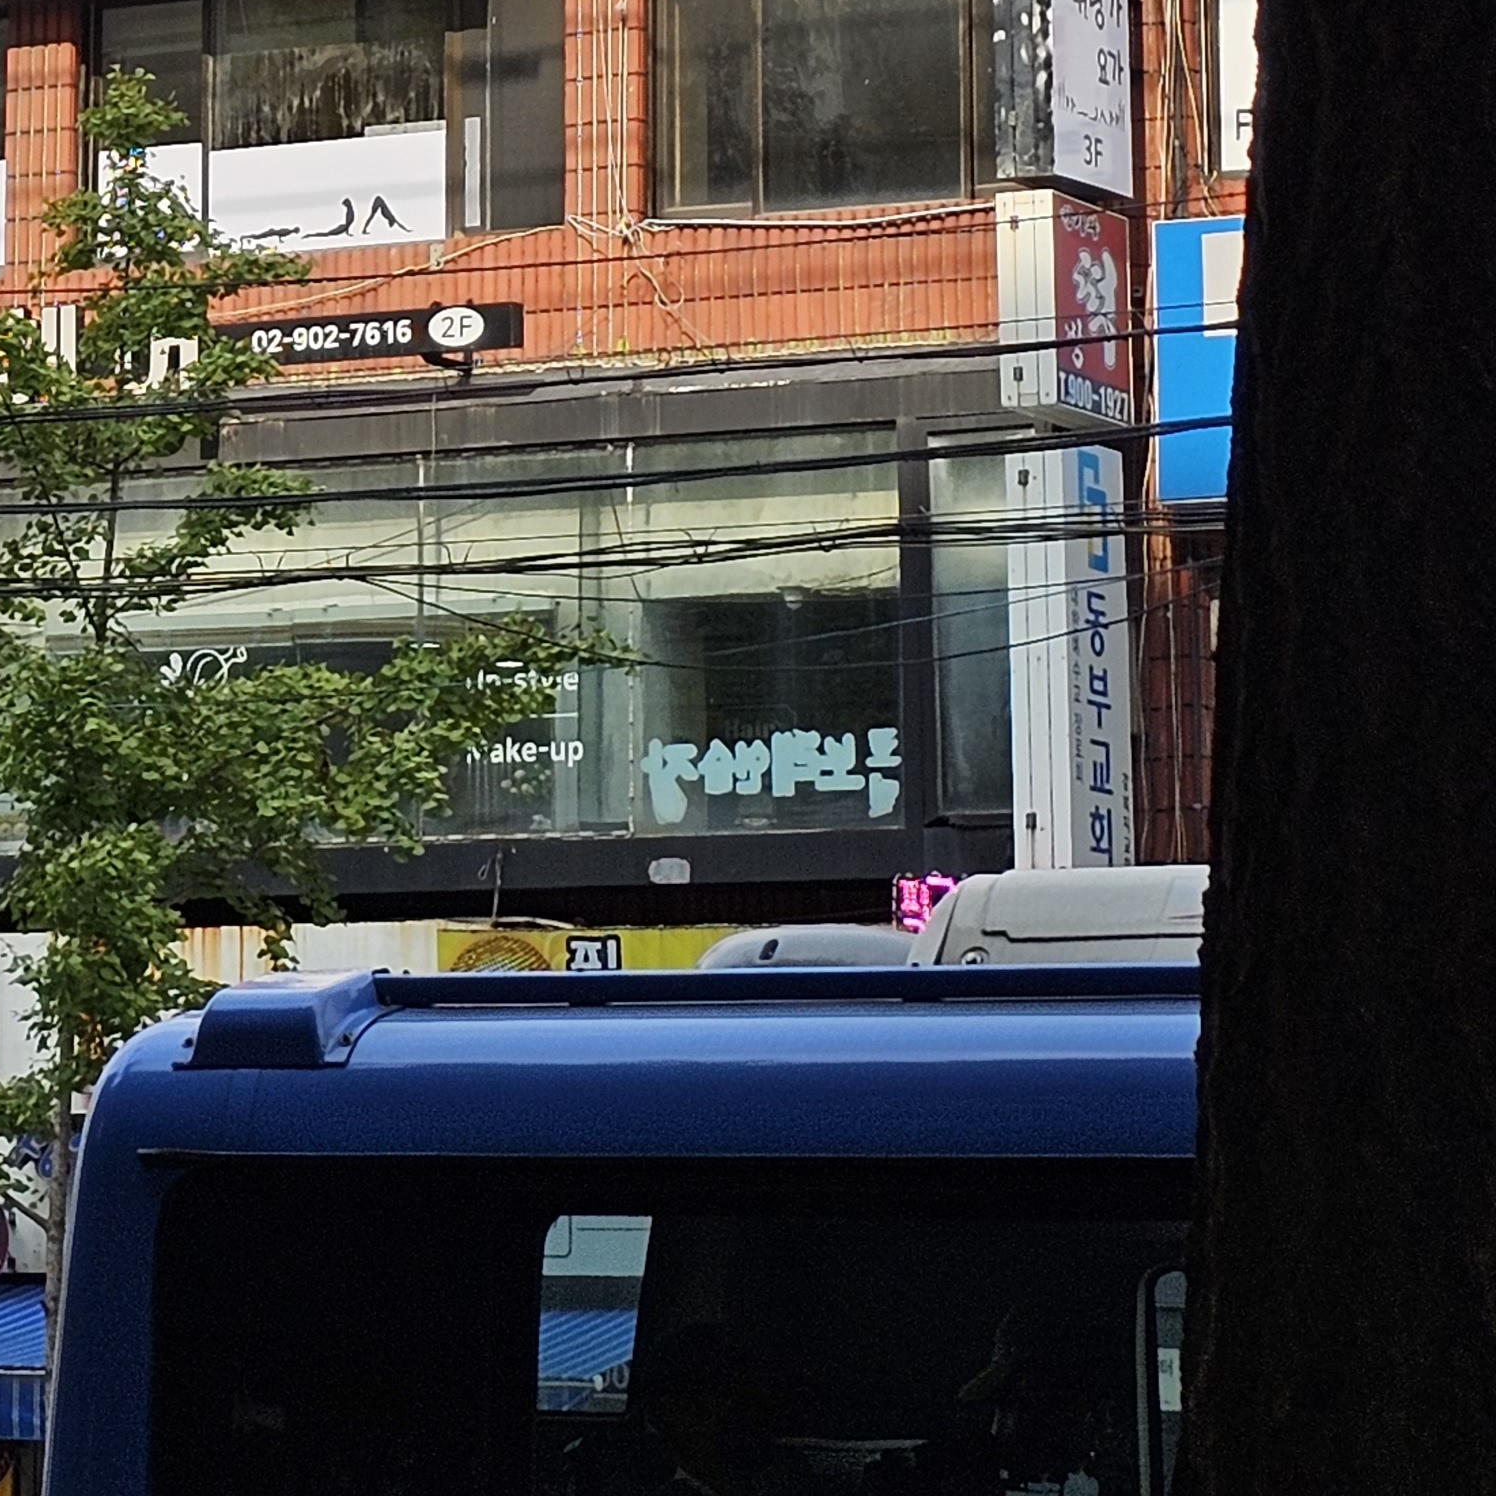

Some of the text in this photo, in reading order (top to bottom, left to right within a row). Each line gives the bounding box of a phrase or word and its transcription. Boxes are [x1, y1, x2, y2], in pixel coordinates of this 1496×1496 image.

[1097, 47, 1125, 87] 요가
[1082, 133, 1104, 169] 3F
[250, 314, 475, 354] 02-902-7616 2F
[1059, 370, 1130, 423] T.900-1927
